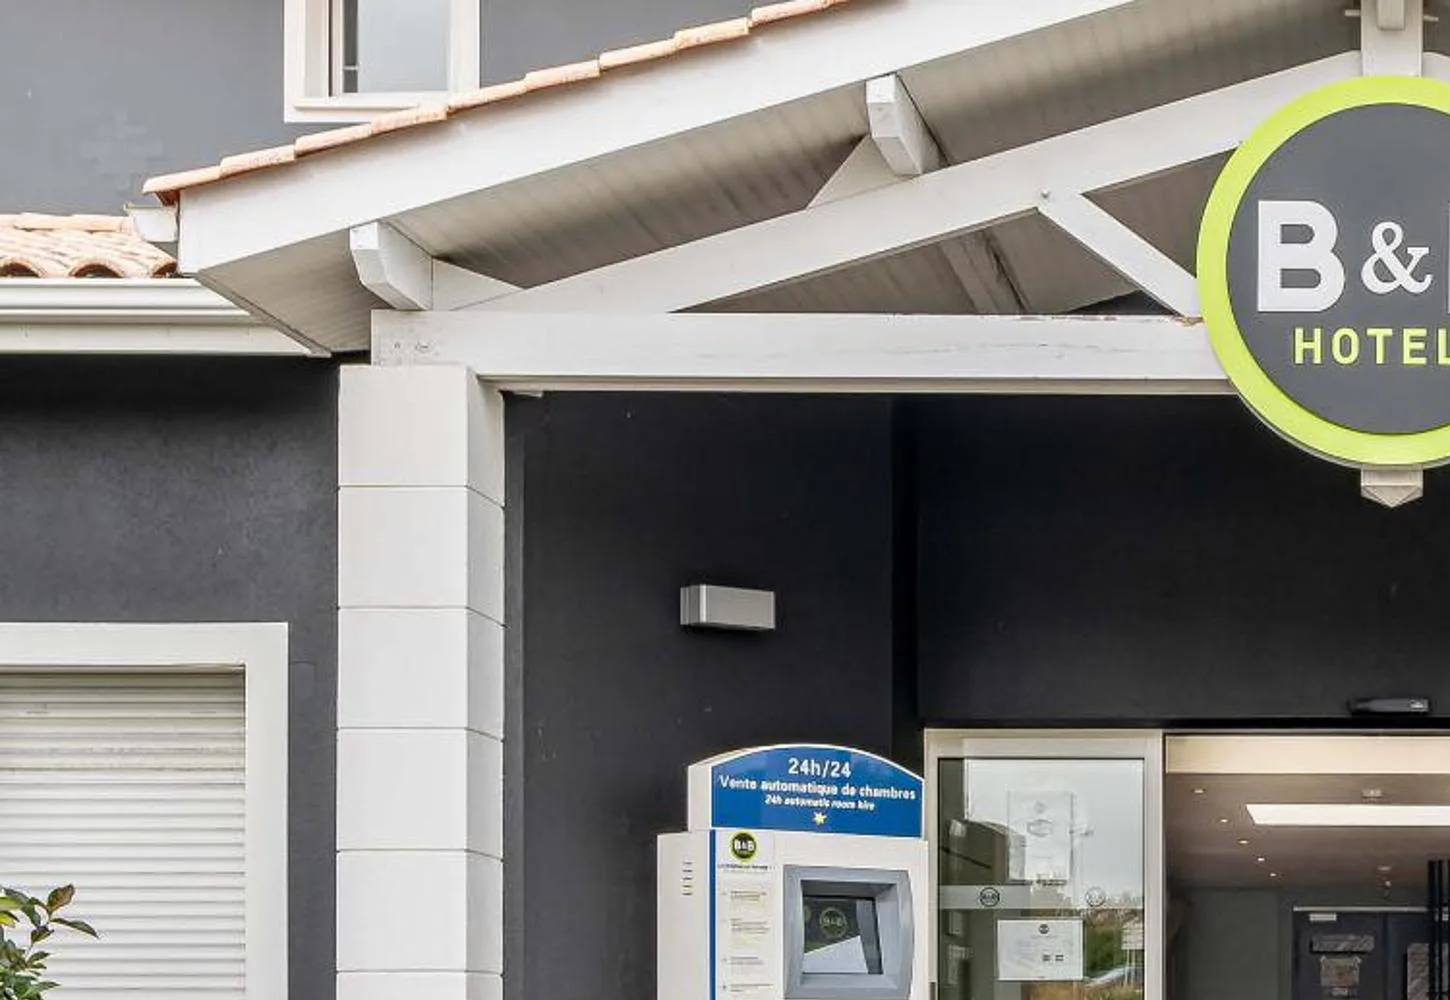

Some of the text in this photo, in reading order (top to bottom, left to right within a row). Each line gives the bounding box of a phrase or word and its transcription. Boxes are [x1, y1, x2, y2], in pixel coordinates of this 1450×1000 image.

[788, 757, 851, 778] 24h/24
[718, 775, 916, 800] Vente automatique de chambres
[765, 794, 782, 805] 24h
[784, 795, 830, 808] automatic
